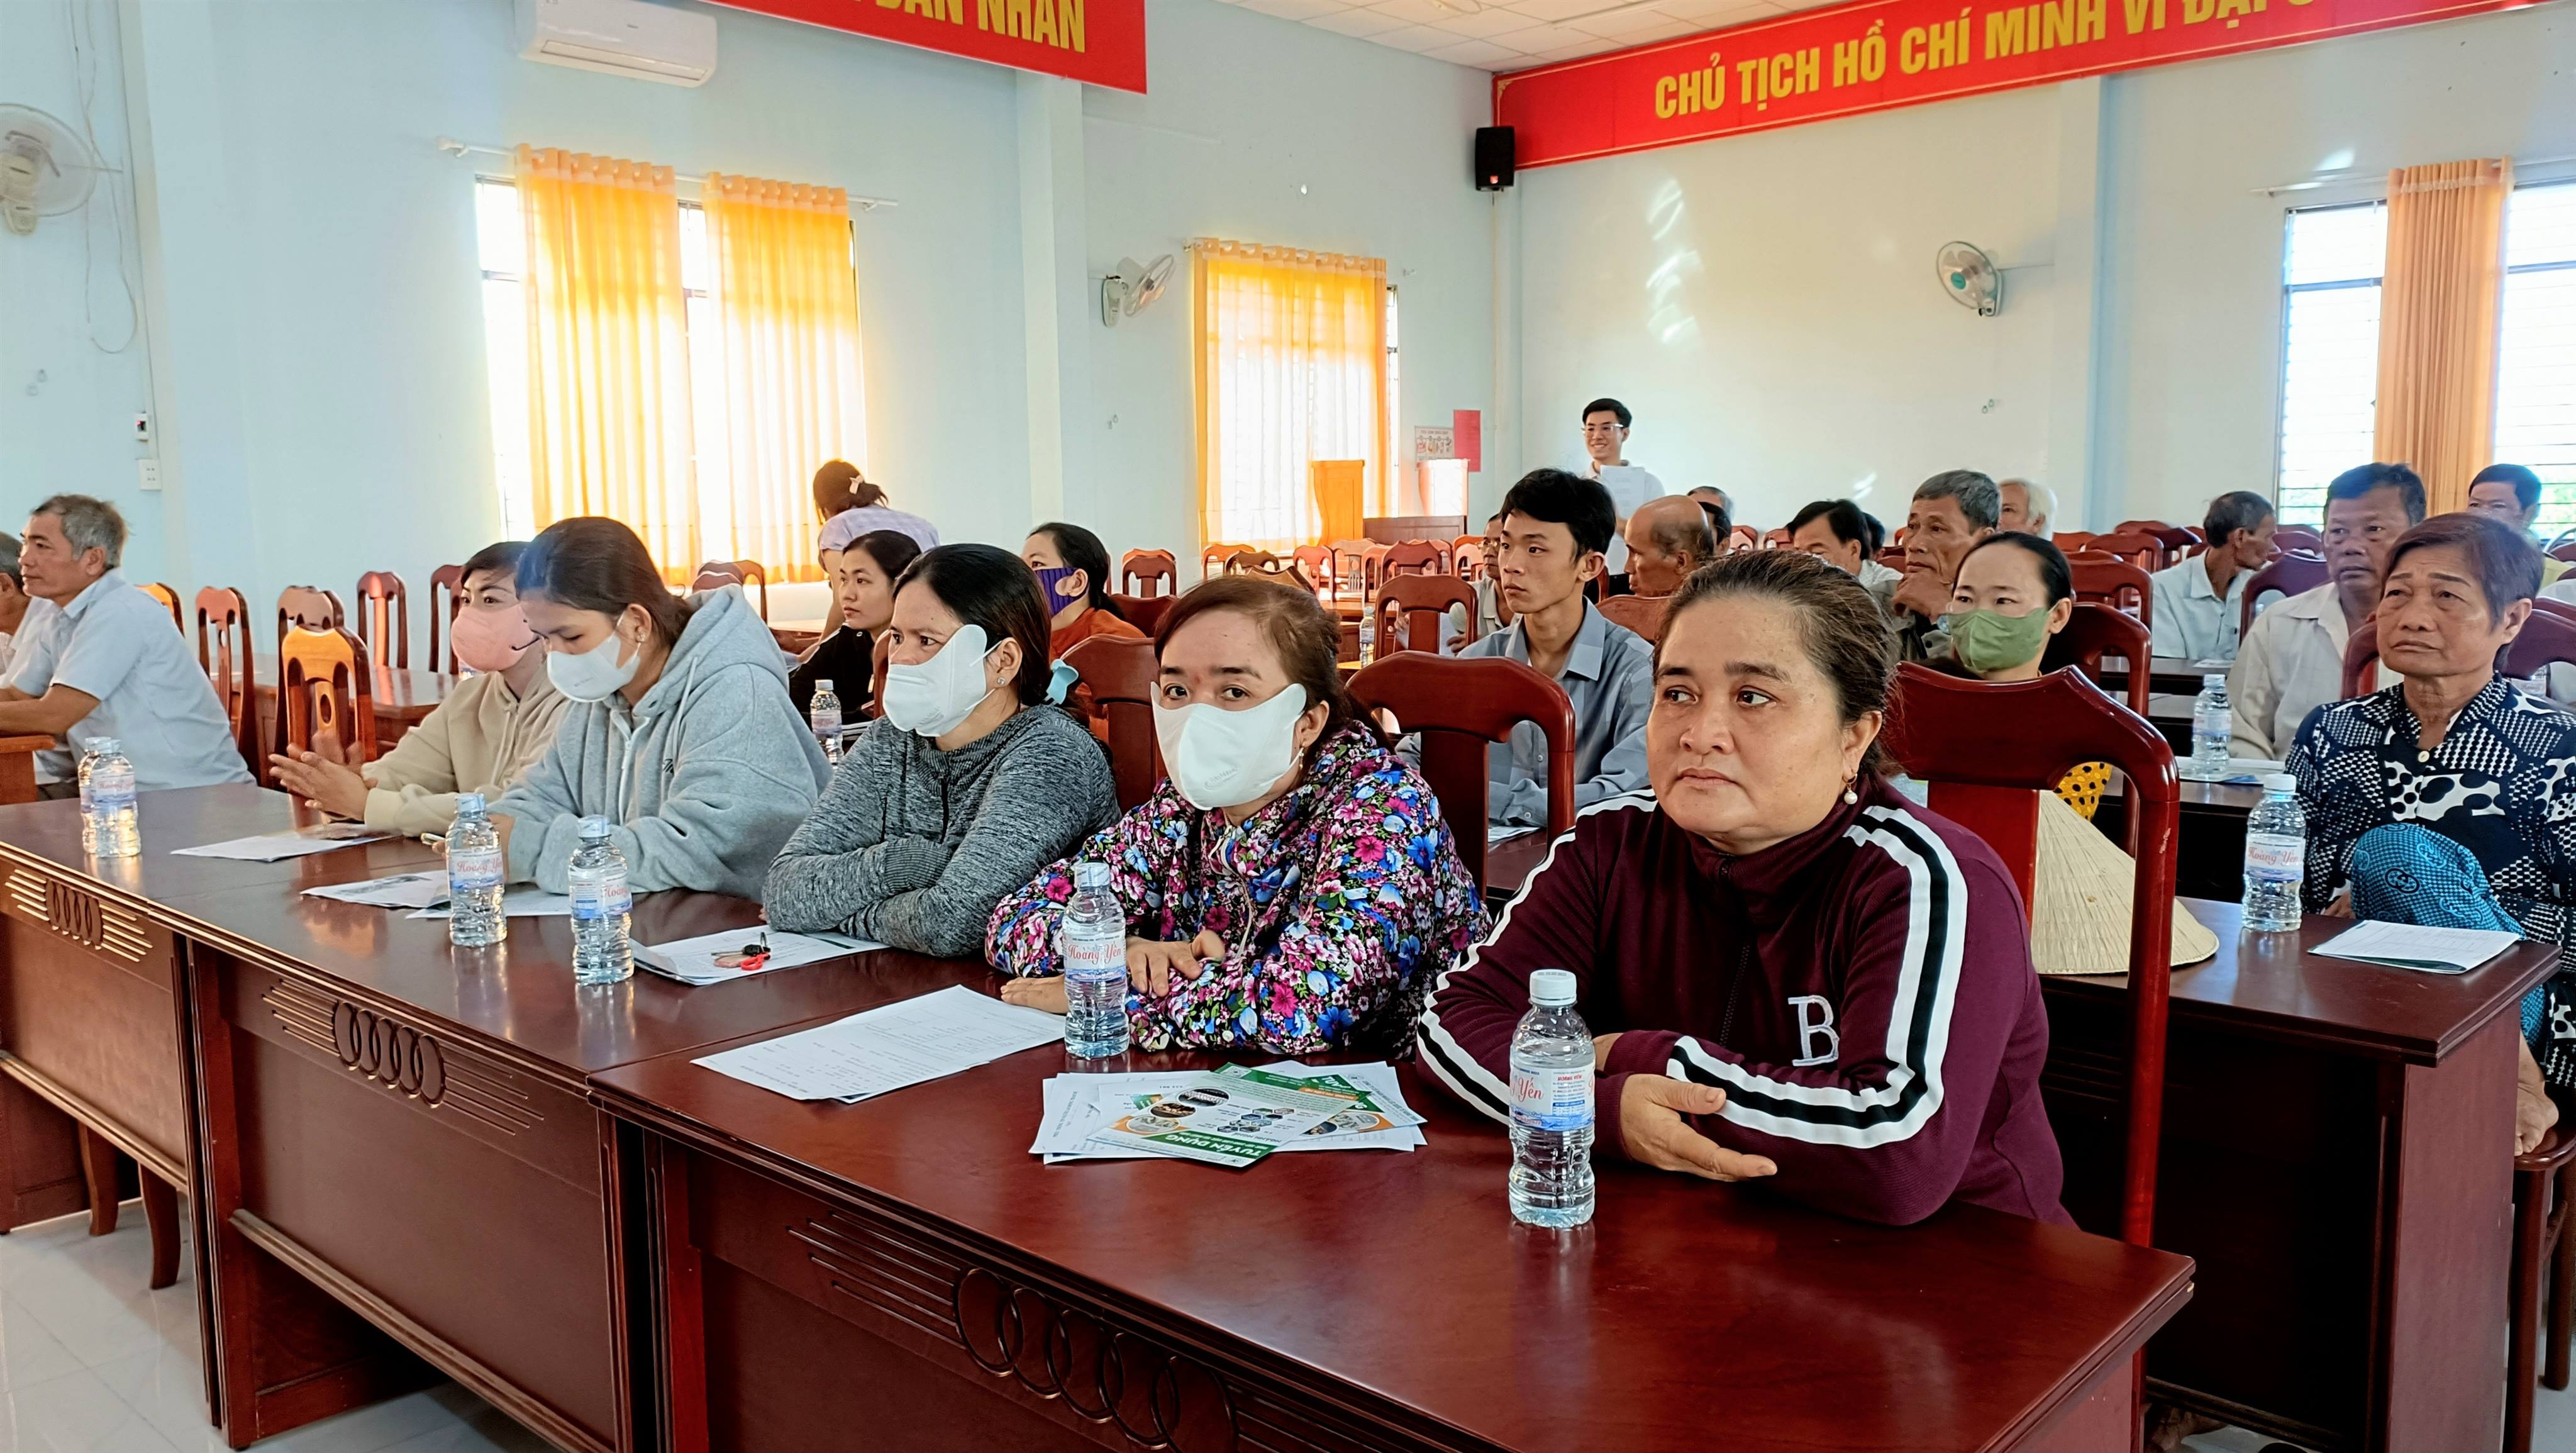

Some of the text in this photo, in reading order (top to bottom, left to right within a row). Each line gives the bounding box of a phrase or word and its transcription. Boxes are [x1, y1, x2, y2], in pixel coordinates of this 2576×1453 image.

[1655, 52, 1726, 119] CHỦ
[1736, 47, 1821, 111] TỊCH
[1833, 19, 1886, 88] HỒ
[1900, 6, 1972, 74] CHÍ
[1985, 0, 2107, 60] MINH
[1069, 940, 1121, 965] Hoàng Yến
[1788, 994, 1840, 1067] B
[1518, 1077, 1544, 1102] Yến
[1165, 1134, 1262, 1156] TUYỂN DỤNG
